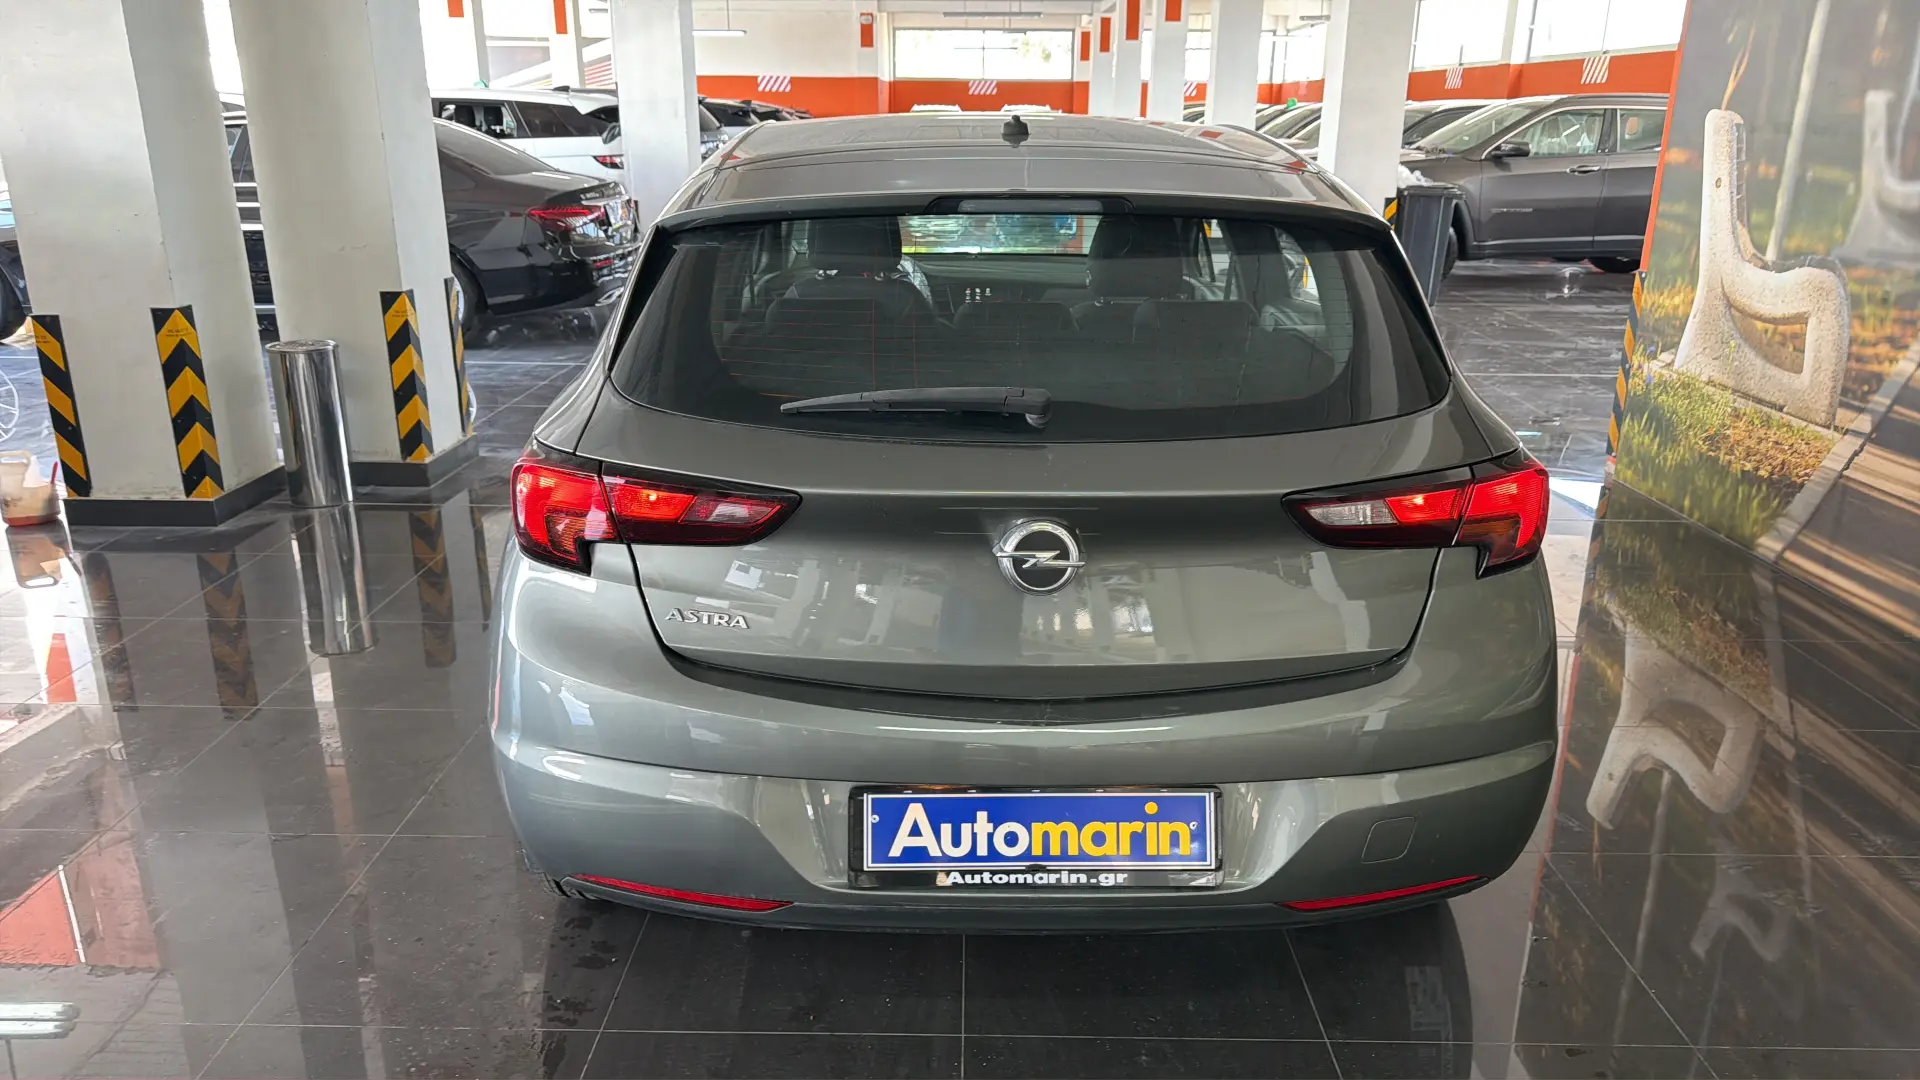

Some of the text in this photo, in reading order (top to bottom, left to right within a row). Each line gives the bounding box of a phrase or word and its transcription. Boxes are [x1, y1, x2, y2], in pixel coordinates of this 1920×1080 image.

[665, 608, 749, 629] ASTRA
[888, 801, 1191, 858] Automarin
[947, 871, 1128, 886] Automarin.gr
